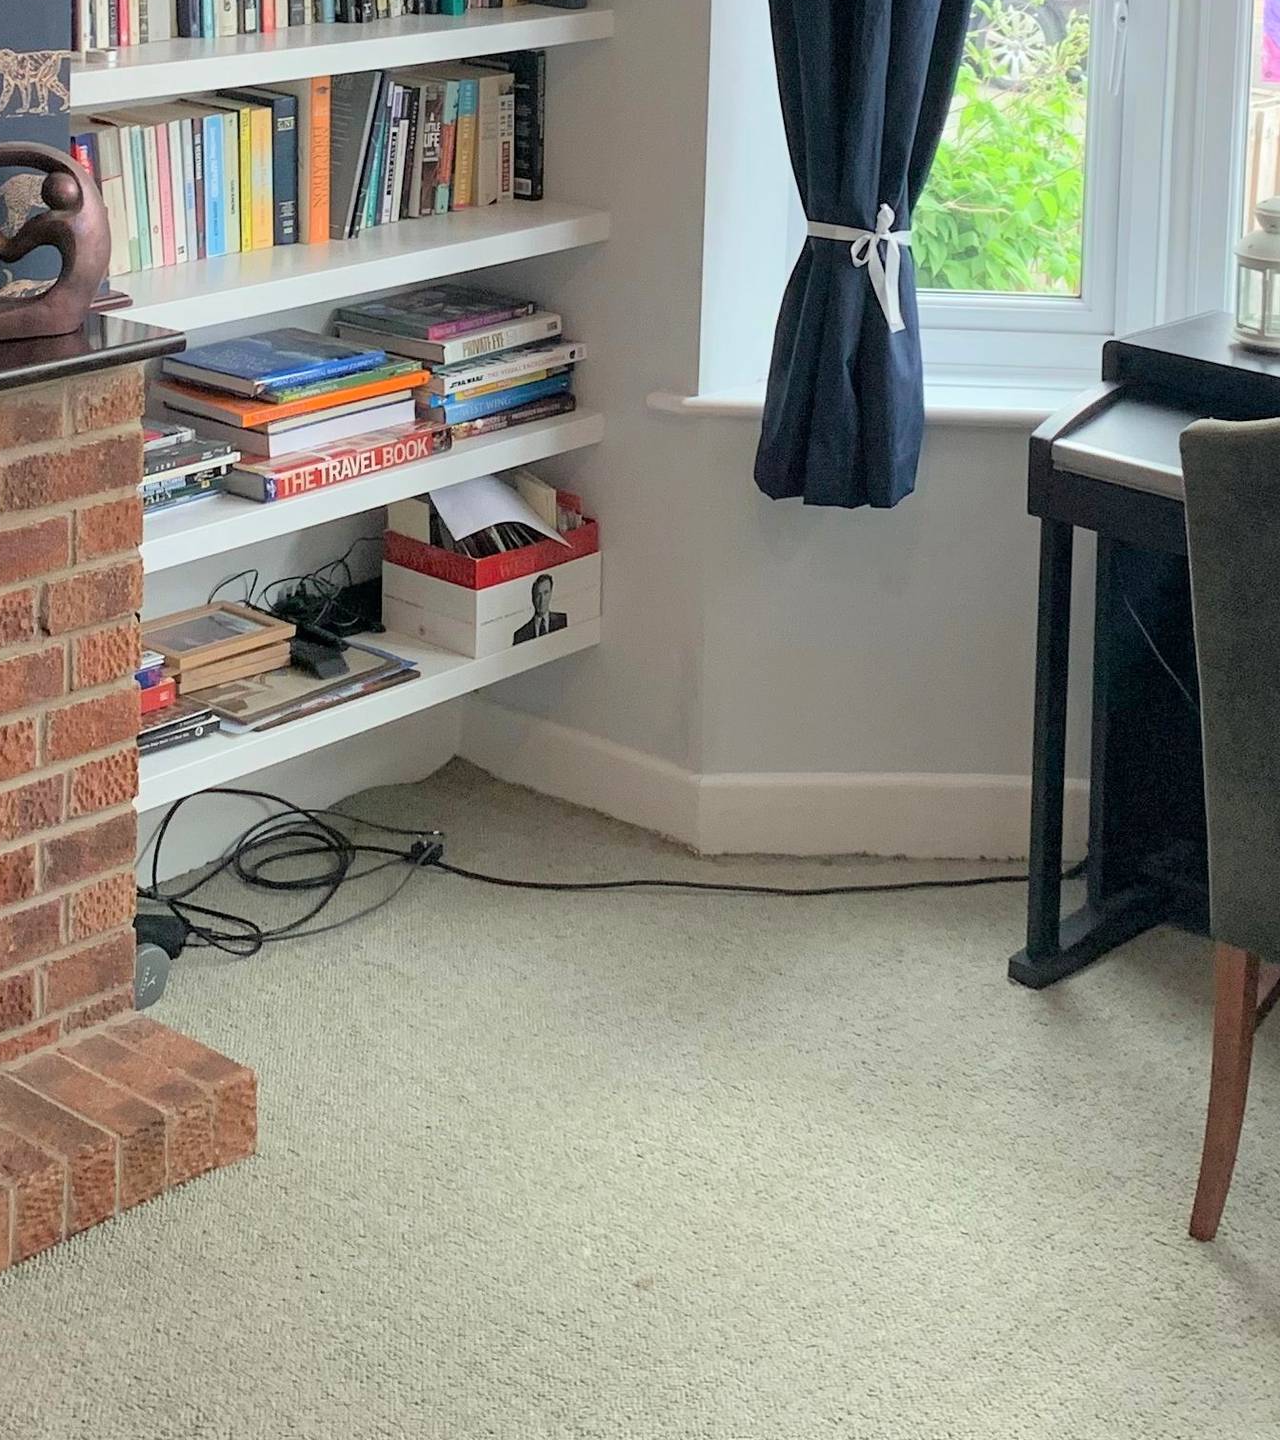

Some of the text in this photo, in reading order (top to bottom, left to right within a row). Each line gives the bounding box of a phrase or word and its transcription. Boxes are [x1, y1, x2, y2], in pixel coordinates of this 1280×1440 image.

[281, 437, 429, 496] THE TRAVEL BOOK
